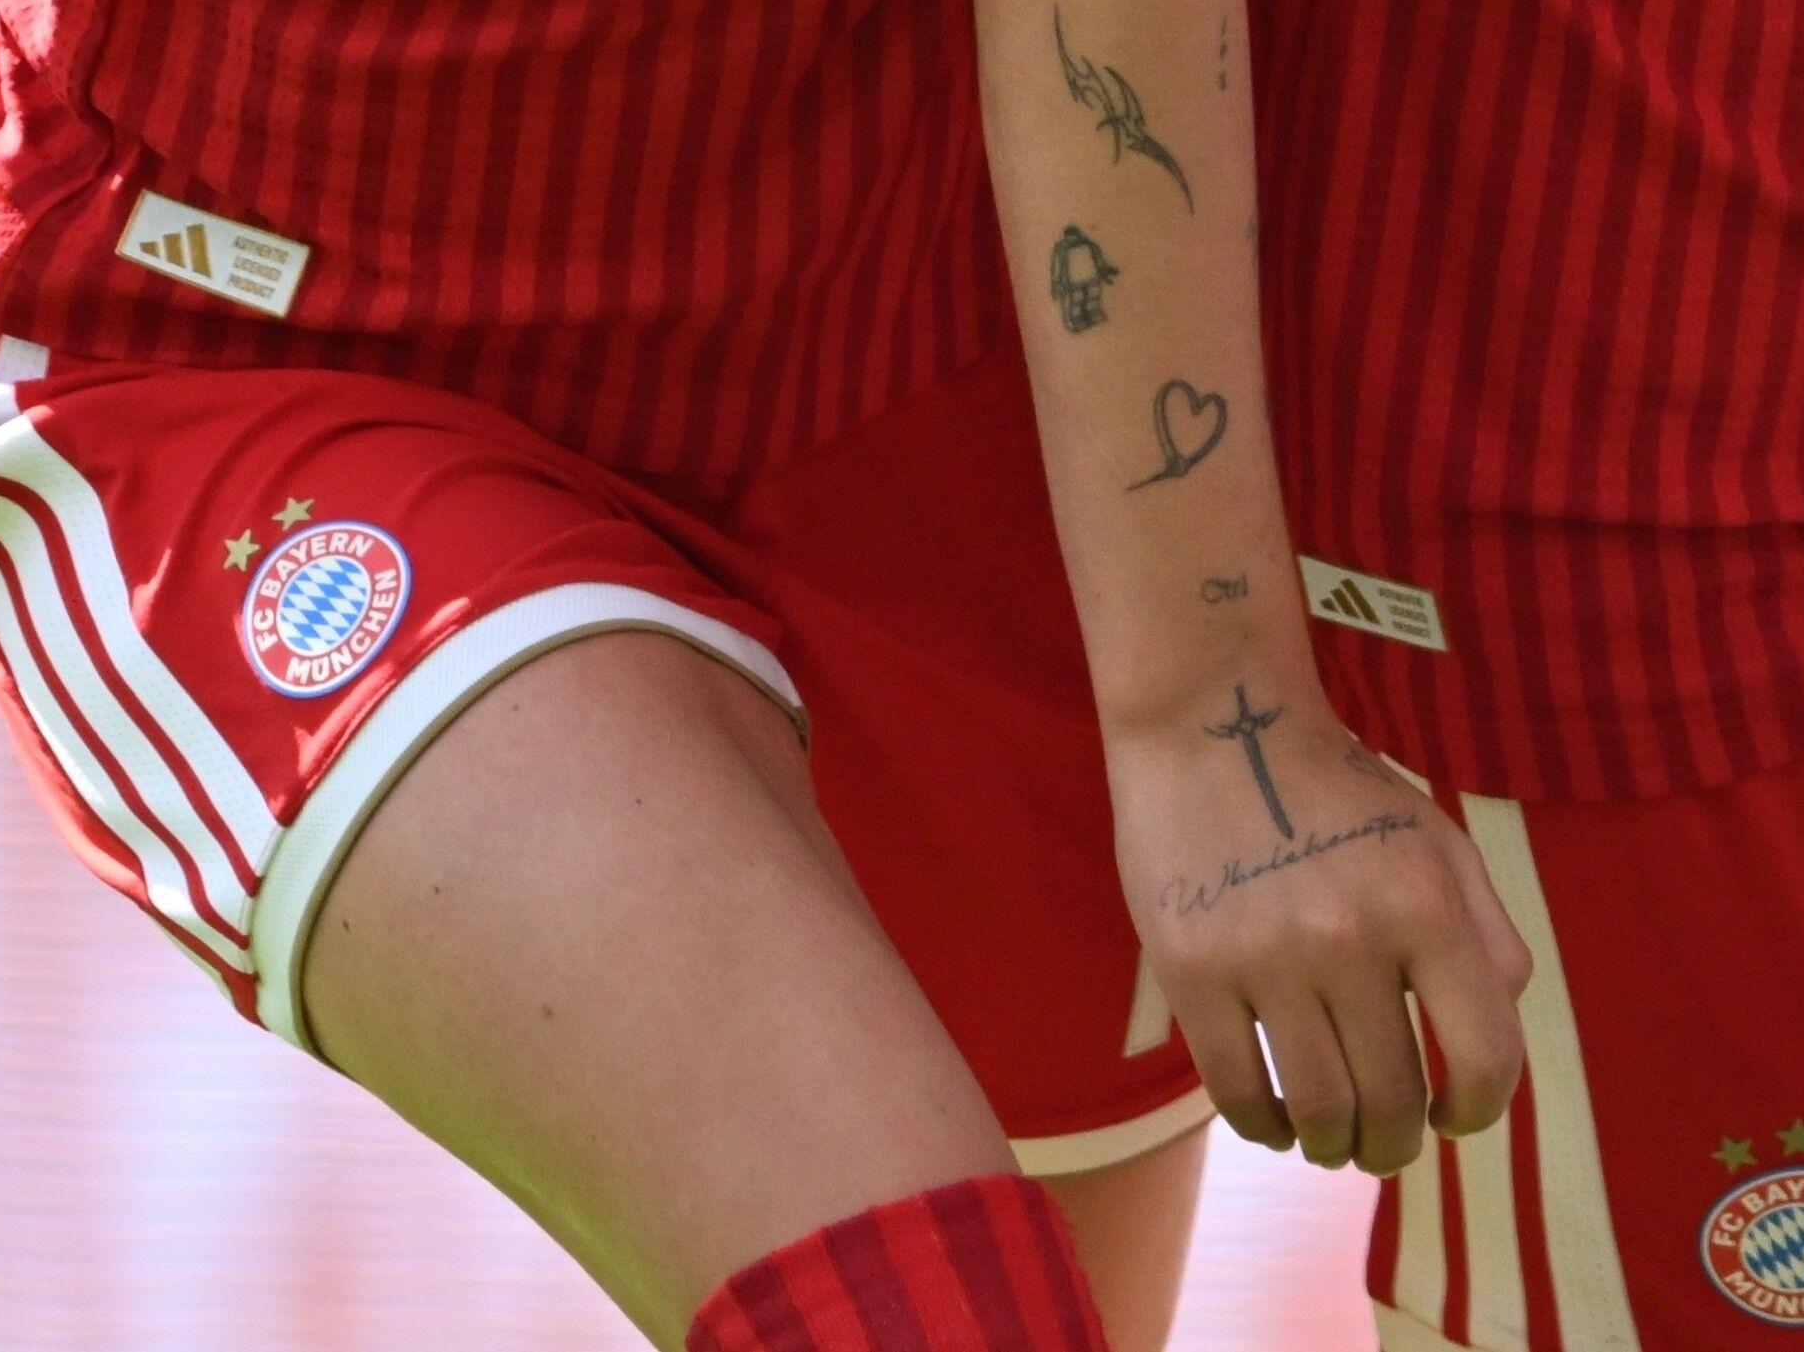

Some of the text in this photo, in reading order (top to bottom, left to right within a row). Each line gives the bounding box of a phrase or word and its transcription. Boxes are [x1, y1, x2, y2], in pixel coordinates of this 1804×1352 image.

[252, 531, 375, 652] FC BAYERN
[284, 567, 398, 685] MÜNCHEN
[1712, 1212, 1746, 1247] FC
